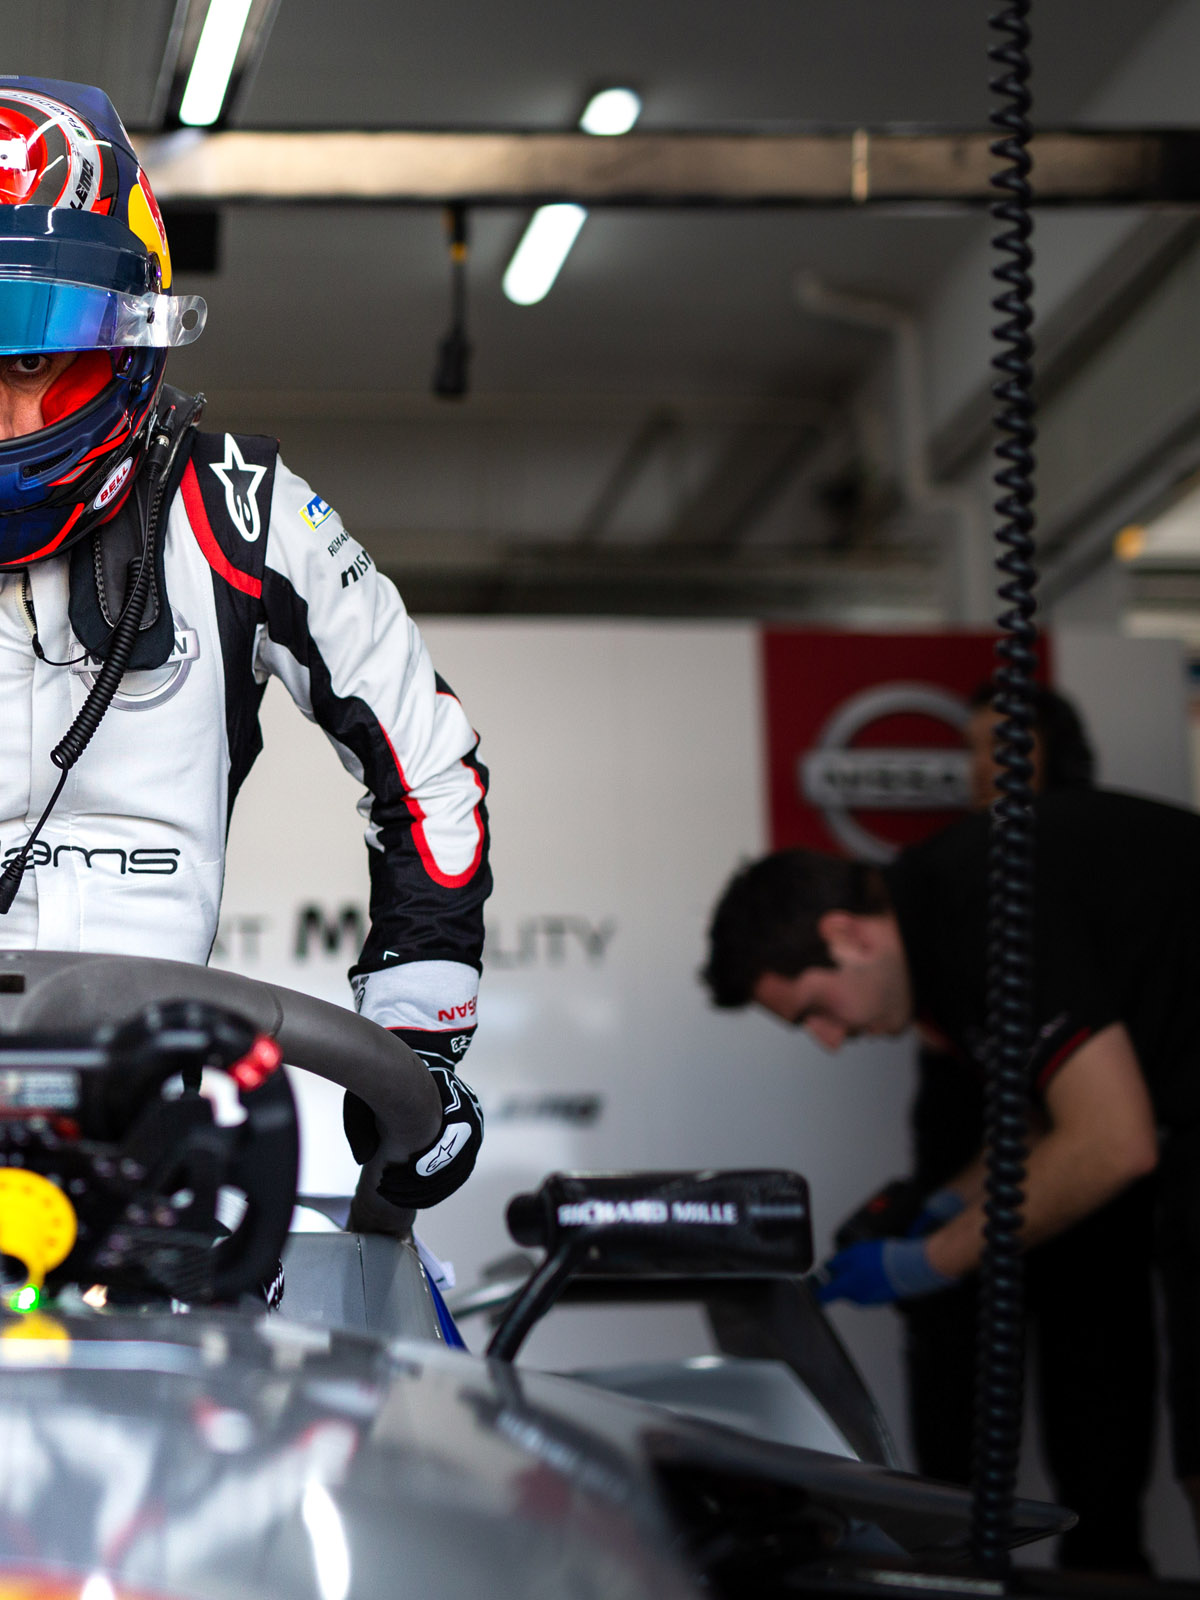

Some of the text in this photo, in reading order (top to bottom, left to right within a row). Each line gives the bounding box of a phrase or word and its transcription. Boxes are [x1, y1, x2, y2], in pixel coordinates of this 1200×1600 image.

[100, 465, 129, 502] BELL
[557, 1200, 668, 1226] RICHARD
[671, 1201, 739, 1224] MILLE
